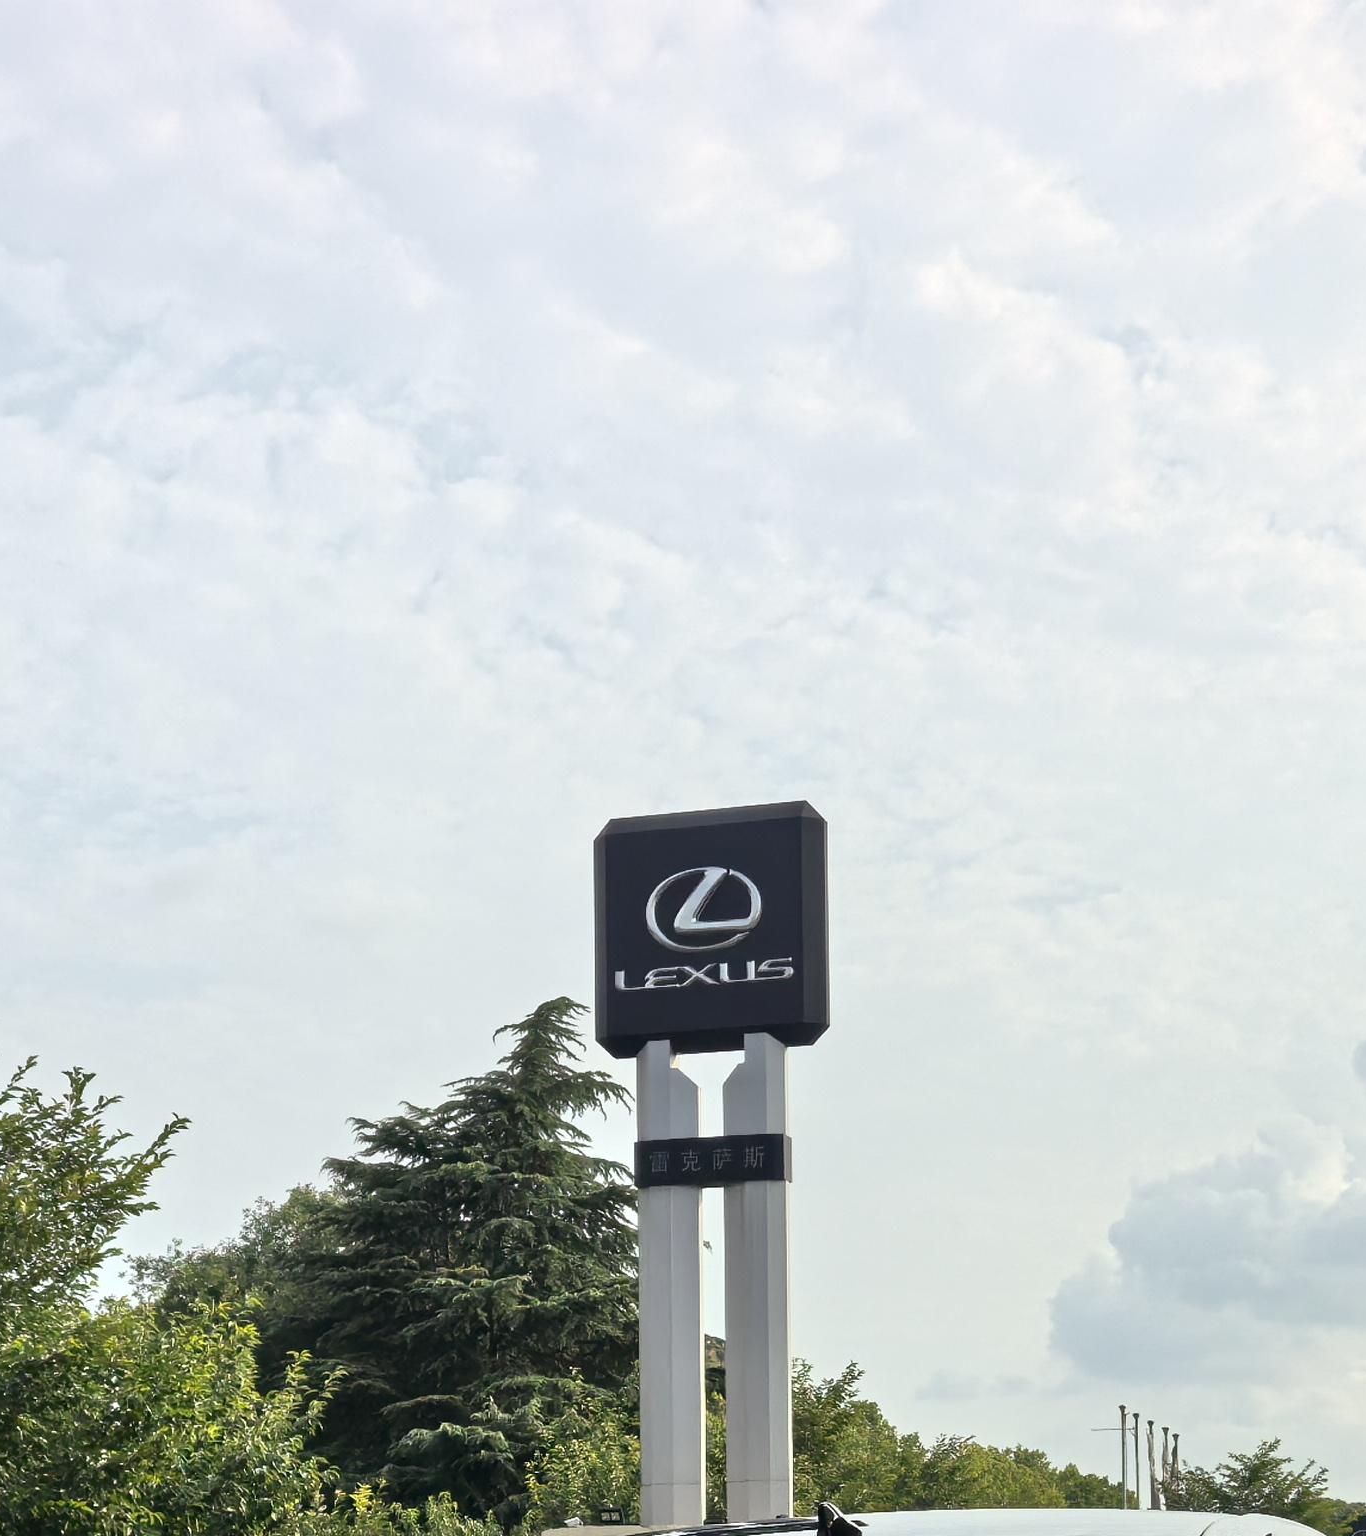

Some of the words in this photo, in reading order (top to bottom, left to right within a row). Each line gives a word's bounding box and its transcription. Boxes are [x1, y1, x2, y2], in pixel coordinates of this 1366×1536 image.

[615, 956, 795, 991] LEXUS
[649, 1144, 766, 1174] 雷克萨斯
